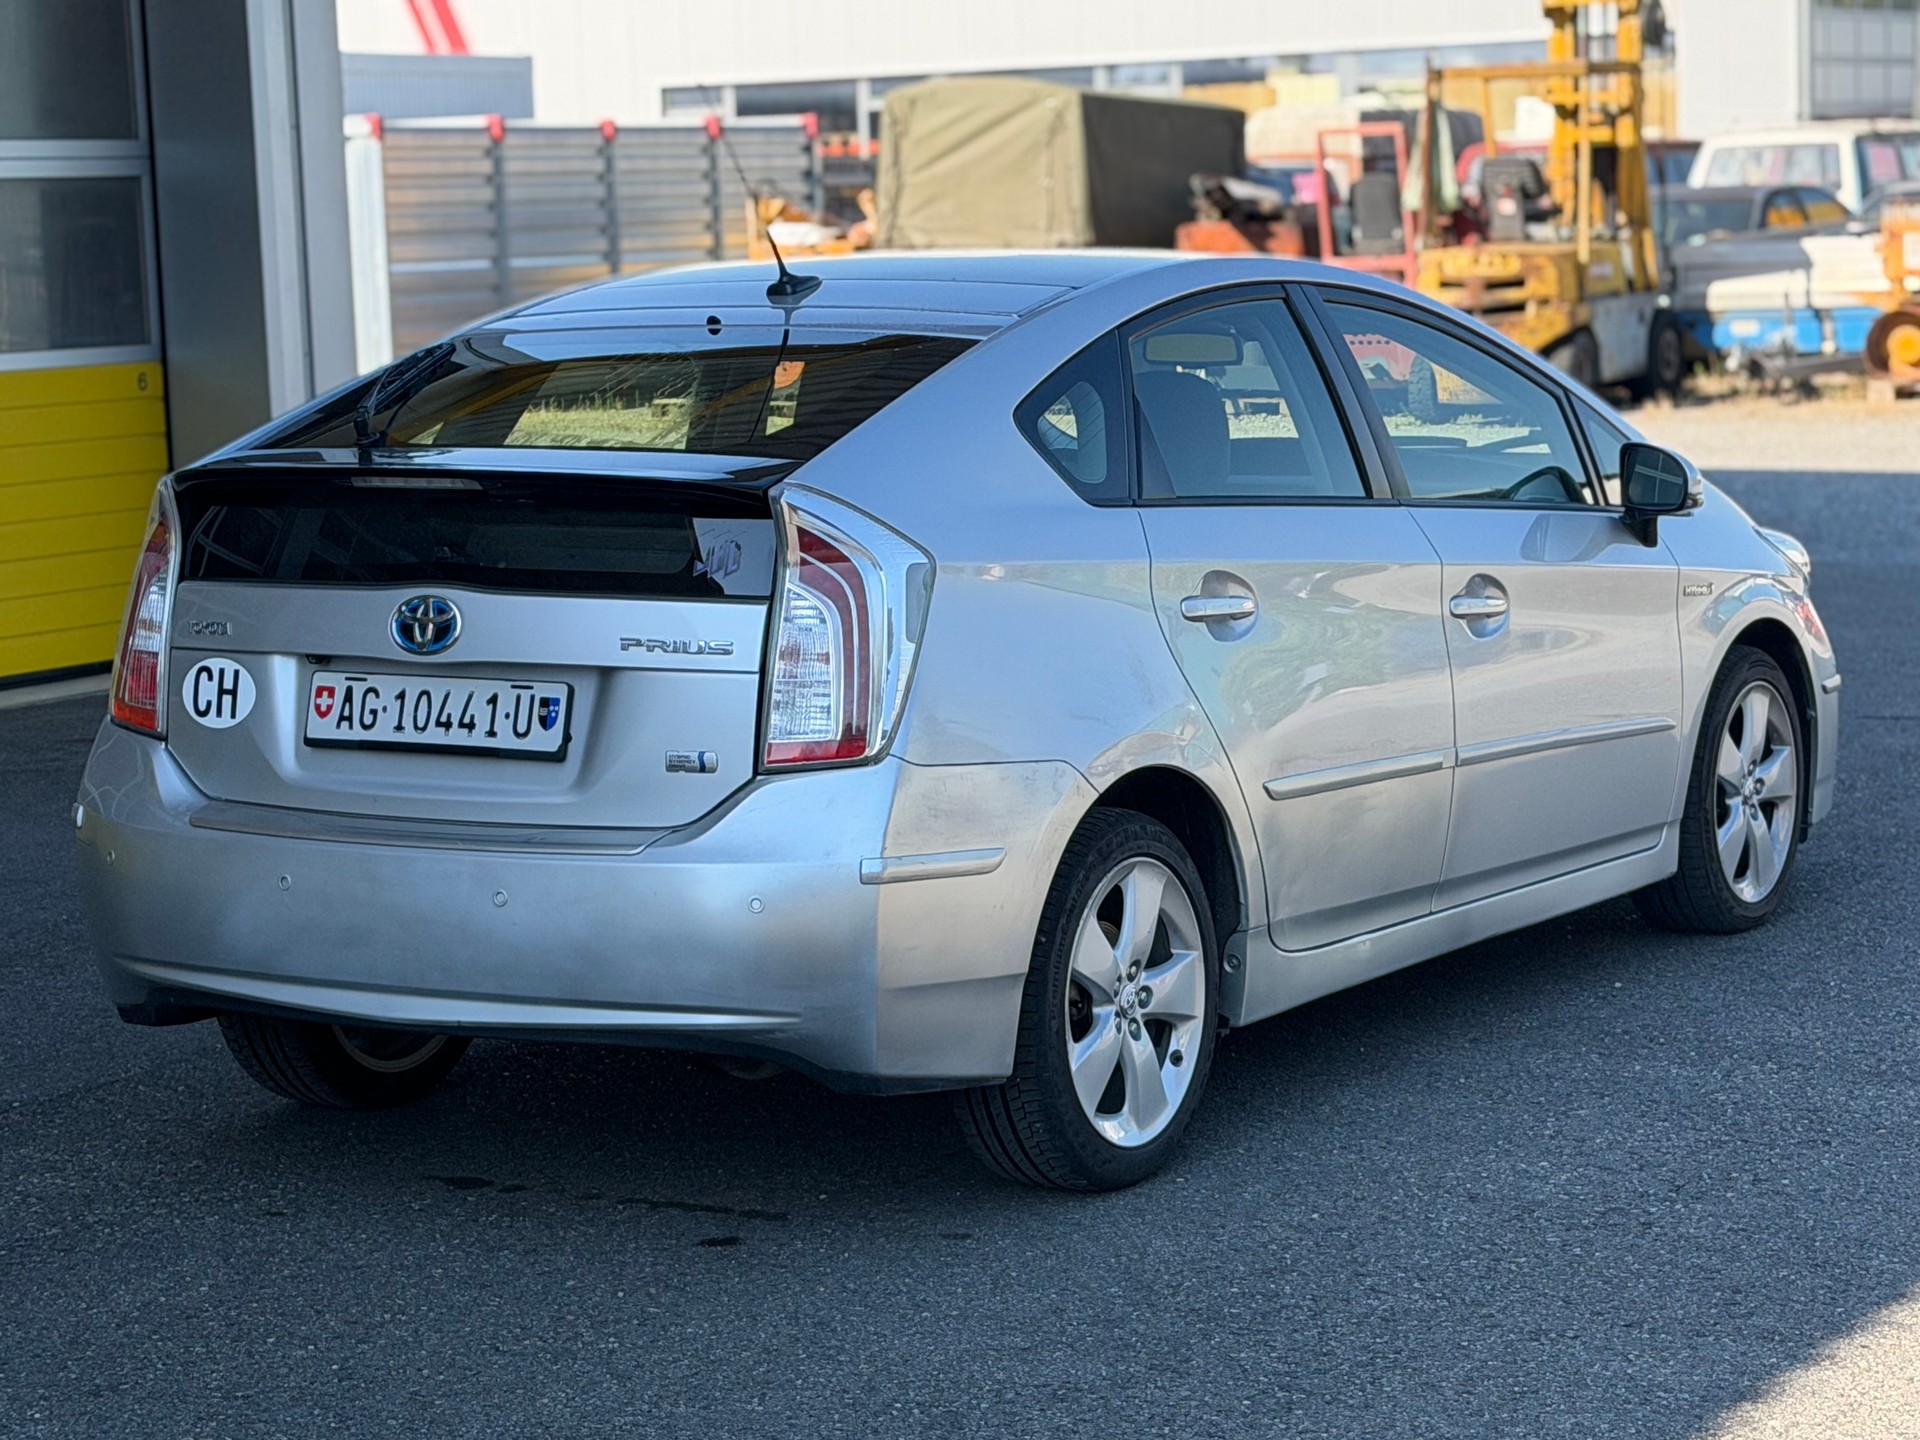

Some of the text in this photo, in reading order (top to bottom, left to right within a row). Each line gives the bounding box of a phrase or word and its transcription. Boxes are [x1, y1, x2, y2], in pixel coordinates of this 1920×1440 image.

[137, 371, 148, 391] 6
[619, 637, 734, 656] PRIUS
[192, 665, 240, 720] CH
